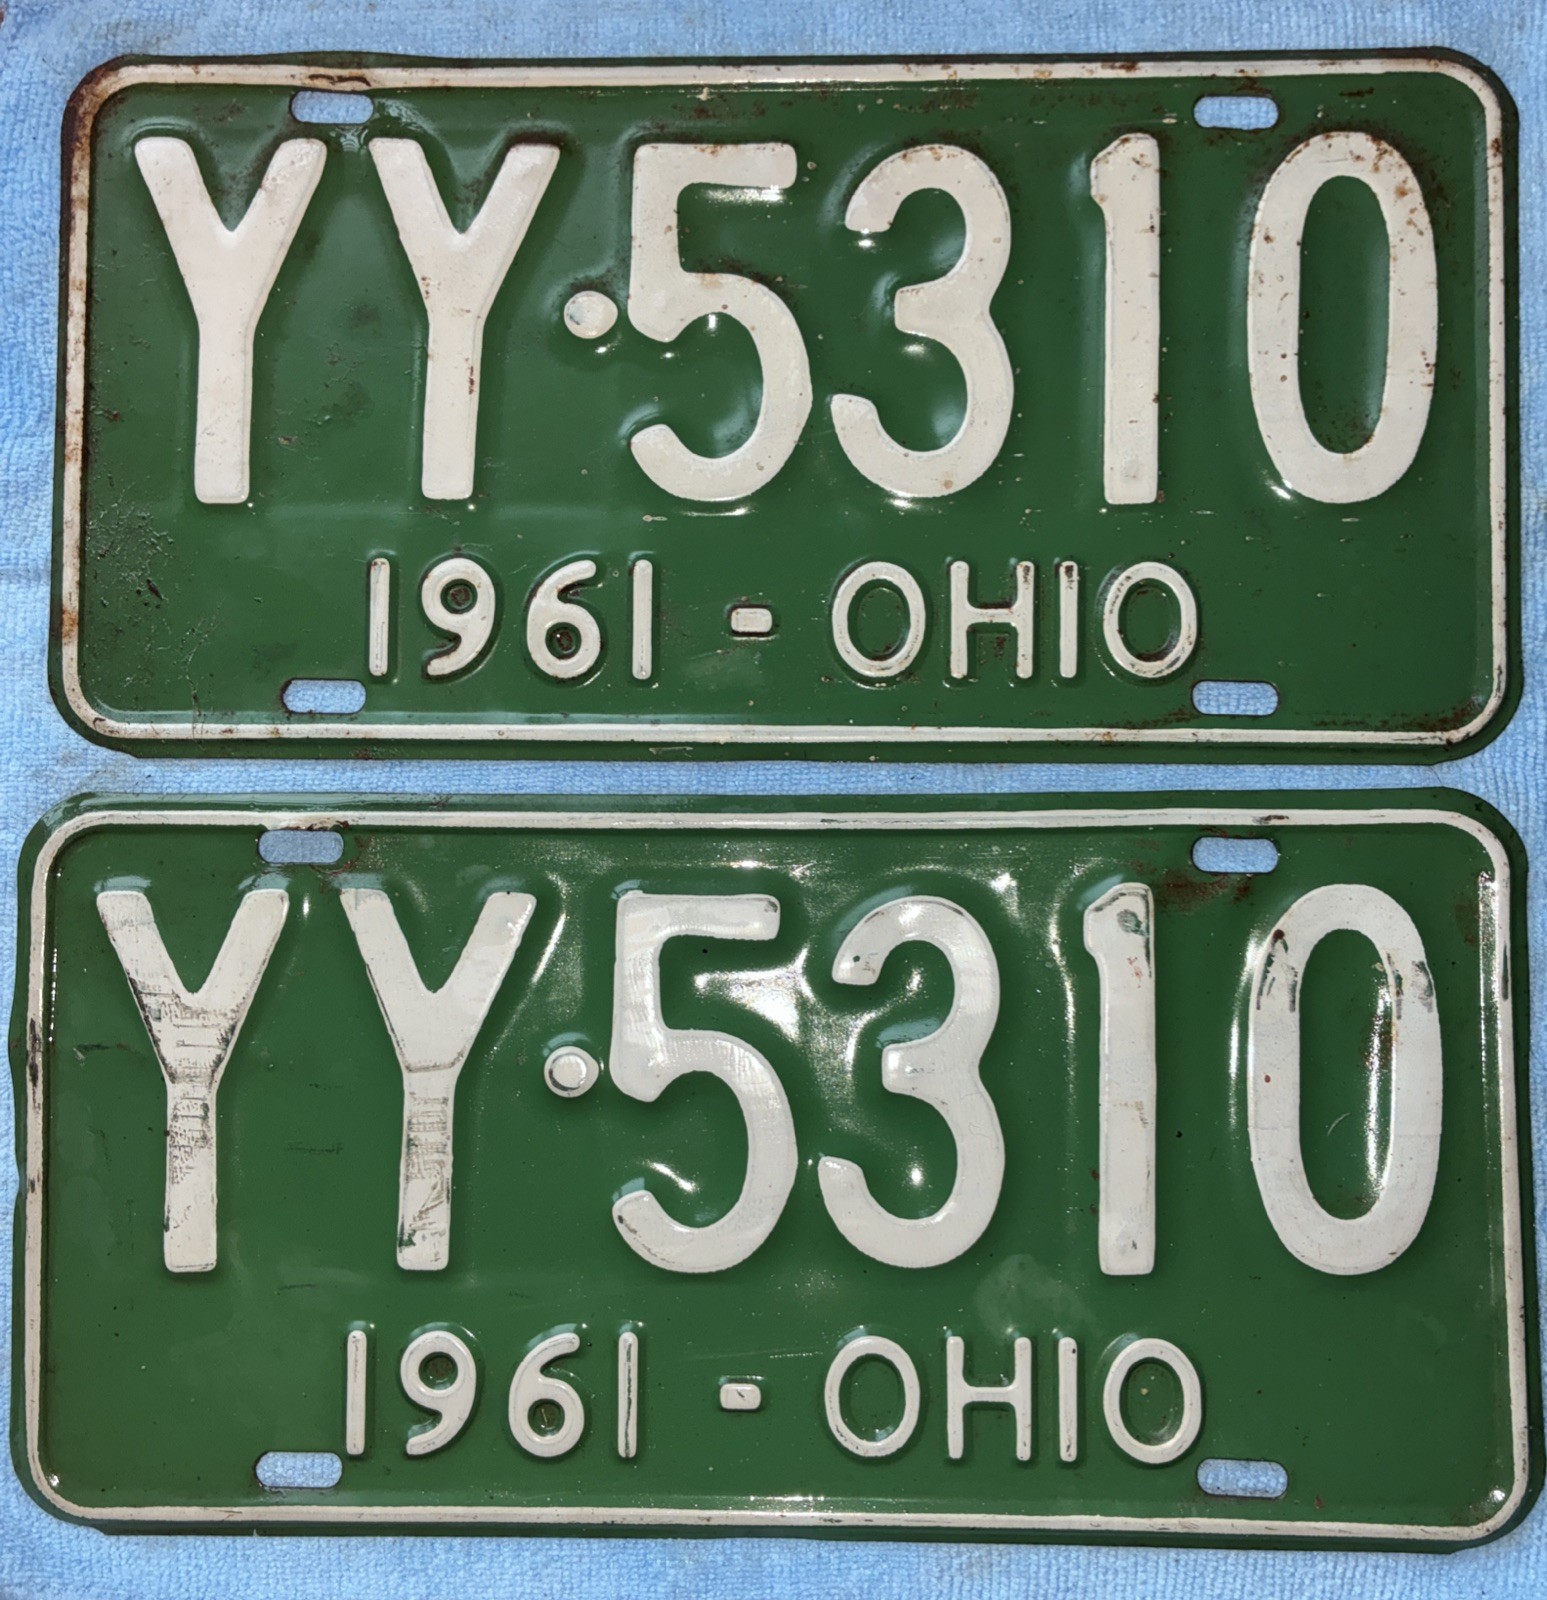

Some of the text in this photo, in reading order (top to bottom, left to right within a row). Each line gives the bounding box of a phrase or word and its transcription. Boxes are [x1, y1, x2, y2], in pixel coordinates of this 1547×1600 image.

[368, 557, 653, 679] 1961
[831, 560, 1198, 679] OHIO
[345, 1329, 638, 1458] 1961
[824, 1334, 1203, 1464] OHIO
